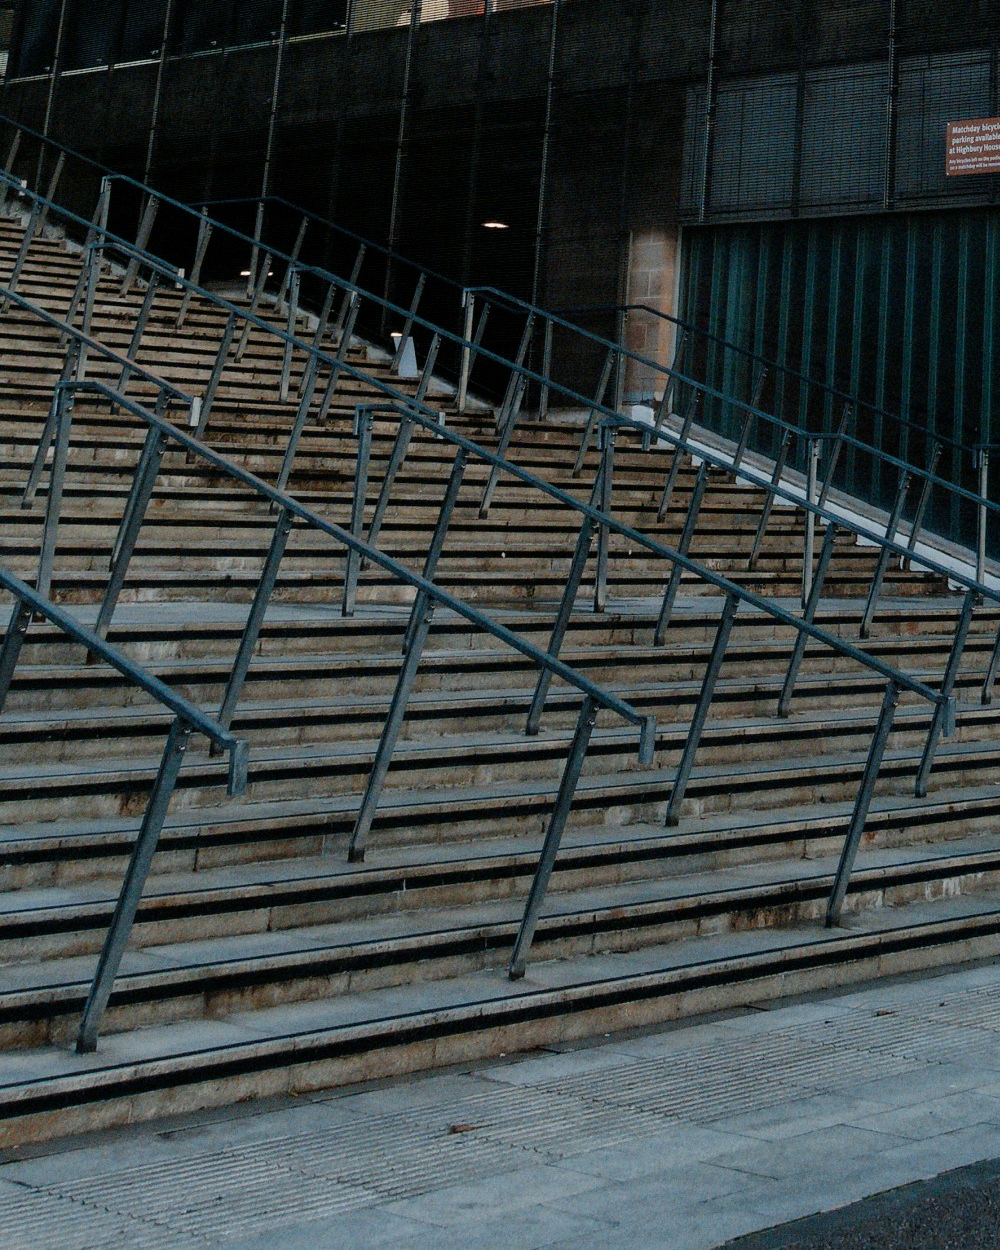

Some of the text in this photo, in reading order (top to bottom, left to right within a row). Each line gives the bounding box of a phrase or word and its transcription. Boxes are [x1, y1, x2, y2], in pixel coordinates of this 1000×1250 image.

[952, 125, 980, 134] Matchday
[952, 133, 1000, 145] parking available
[956, 145, 983, 154] Highbury
